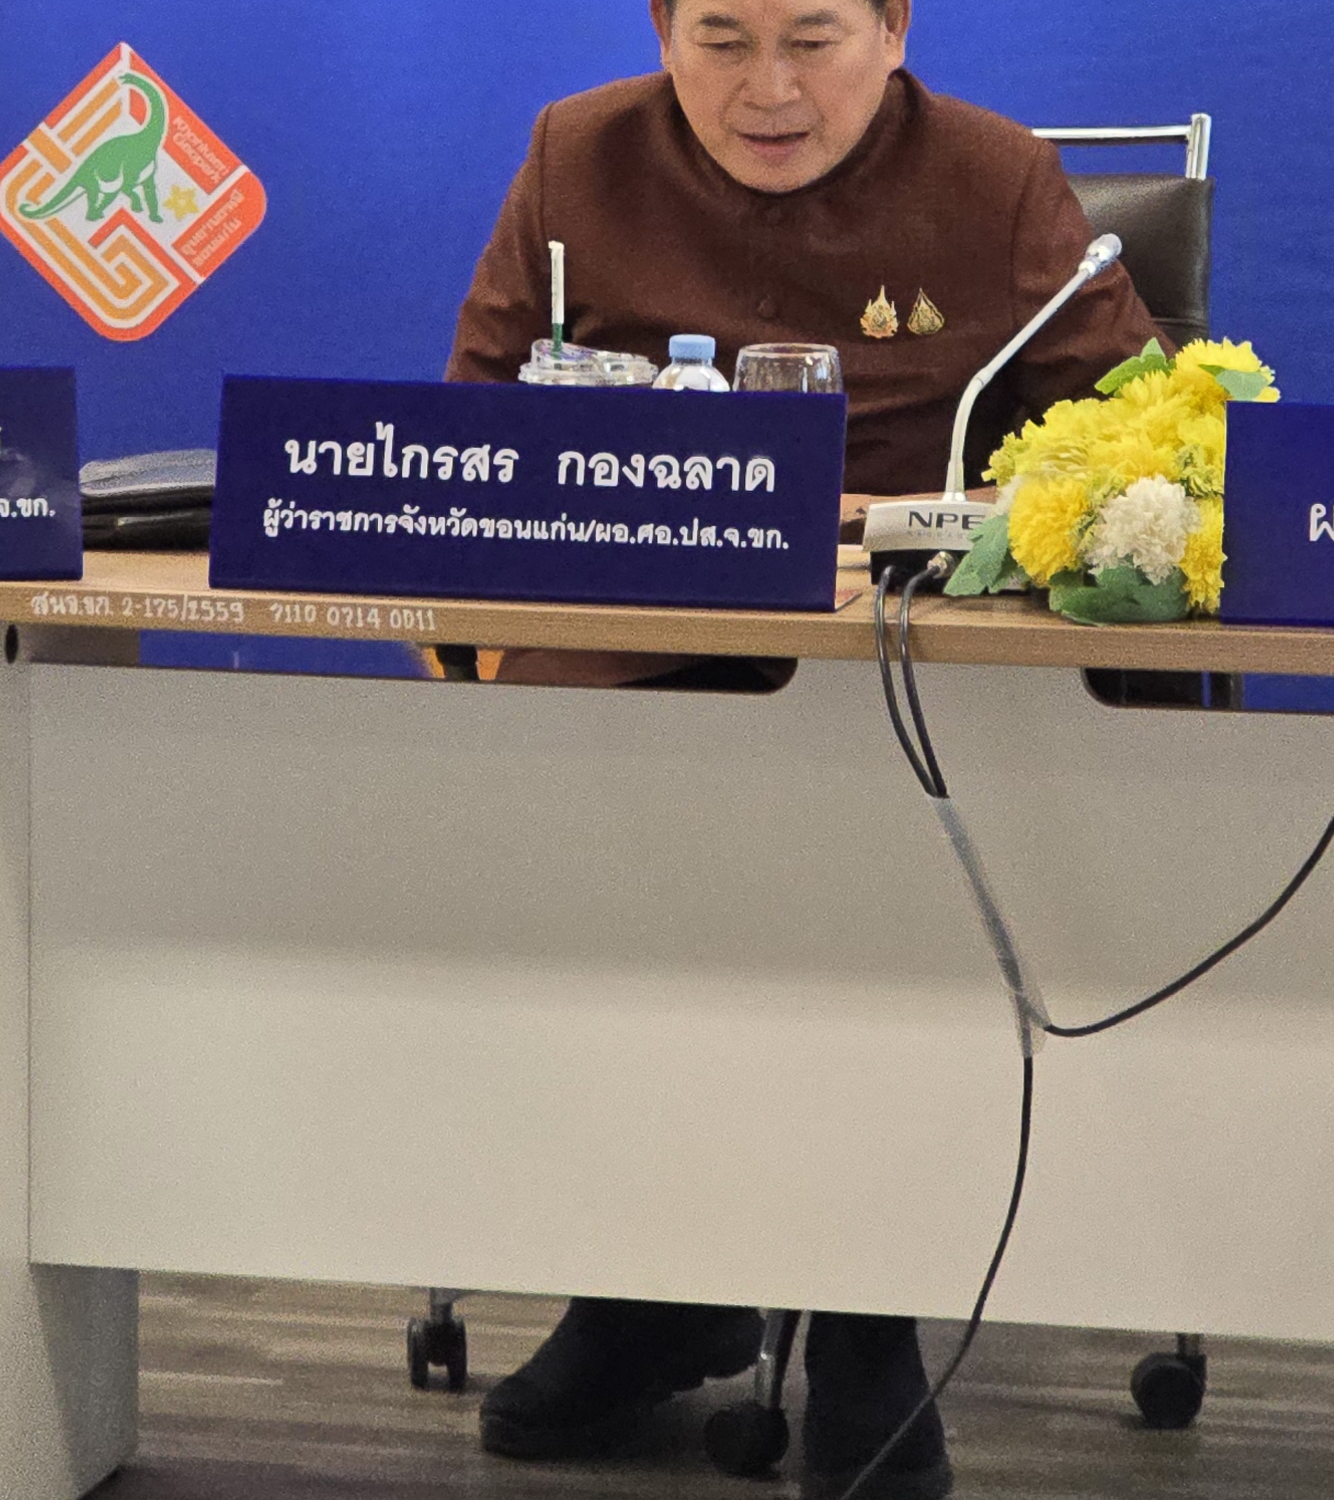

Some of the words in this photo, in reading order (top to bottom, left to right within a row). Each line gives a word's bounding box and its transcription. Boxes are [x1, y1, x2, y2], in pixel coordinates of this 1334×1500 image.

[284, 421, 520, 483] นายไกรสร
[557, 450, 775, 493] กองฉลาด
[908, 510, 986, 531] NPE
[326, 605, 381, 629] 0714
